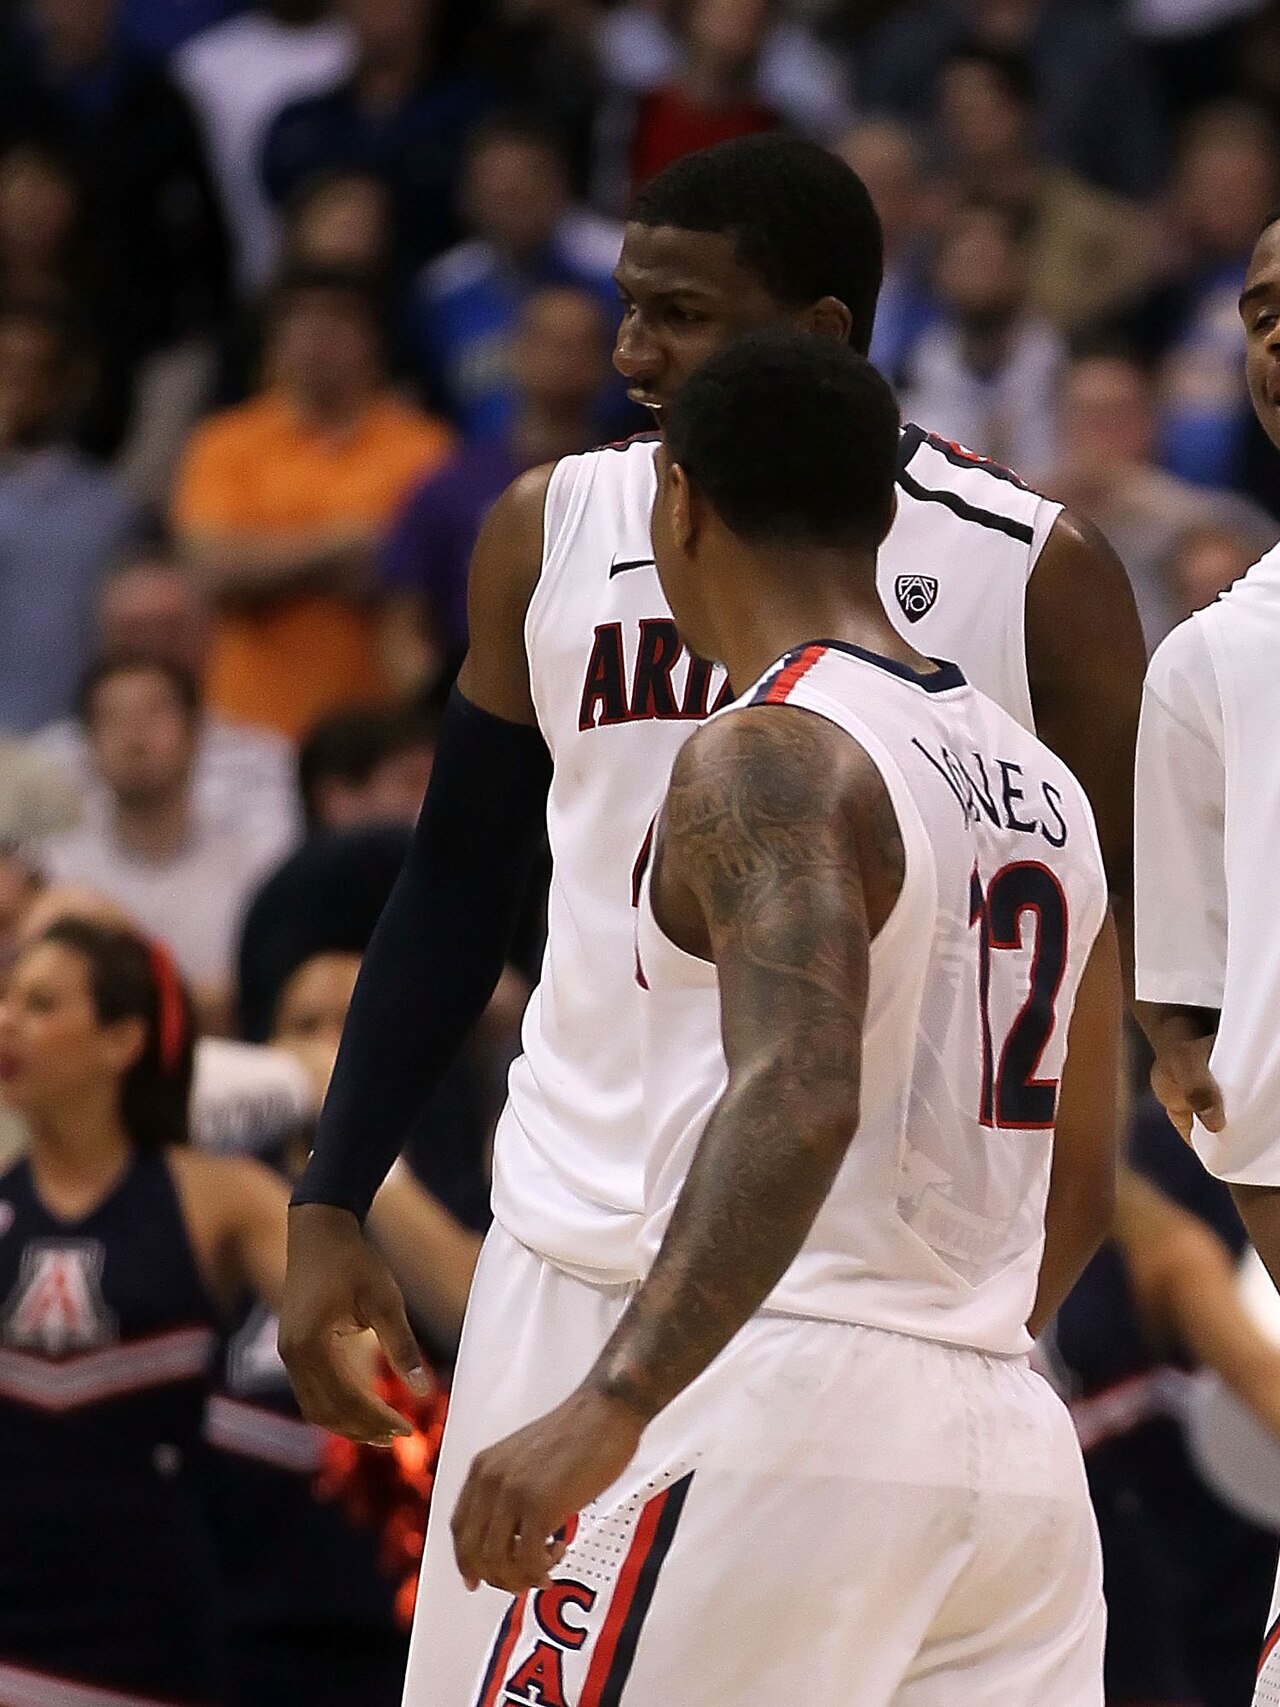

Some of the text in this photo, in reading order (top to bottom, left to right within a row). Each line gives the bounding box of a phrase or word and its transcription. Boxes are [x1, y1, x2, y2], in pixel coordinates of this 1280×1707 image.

[898, 576, 935, 604] PAC
[905, 594, 927, 612] 10
[578, 618, 737, 732] ARI
[968, 853, 1069, 1130] 12
[503, 1578, 597, 1707] CA
